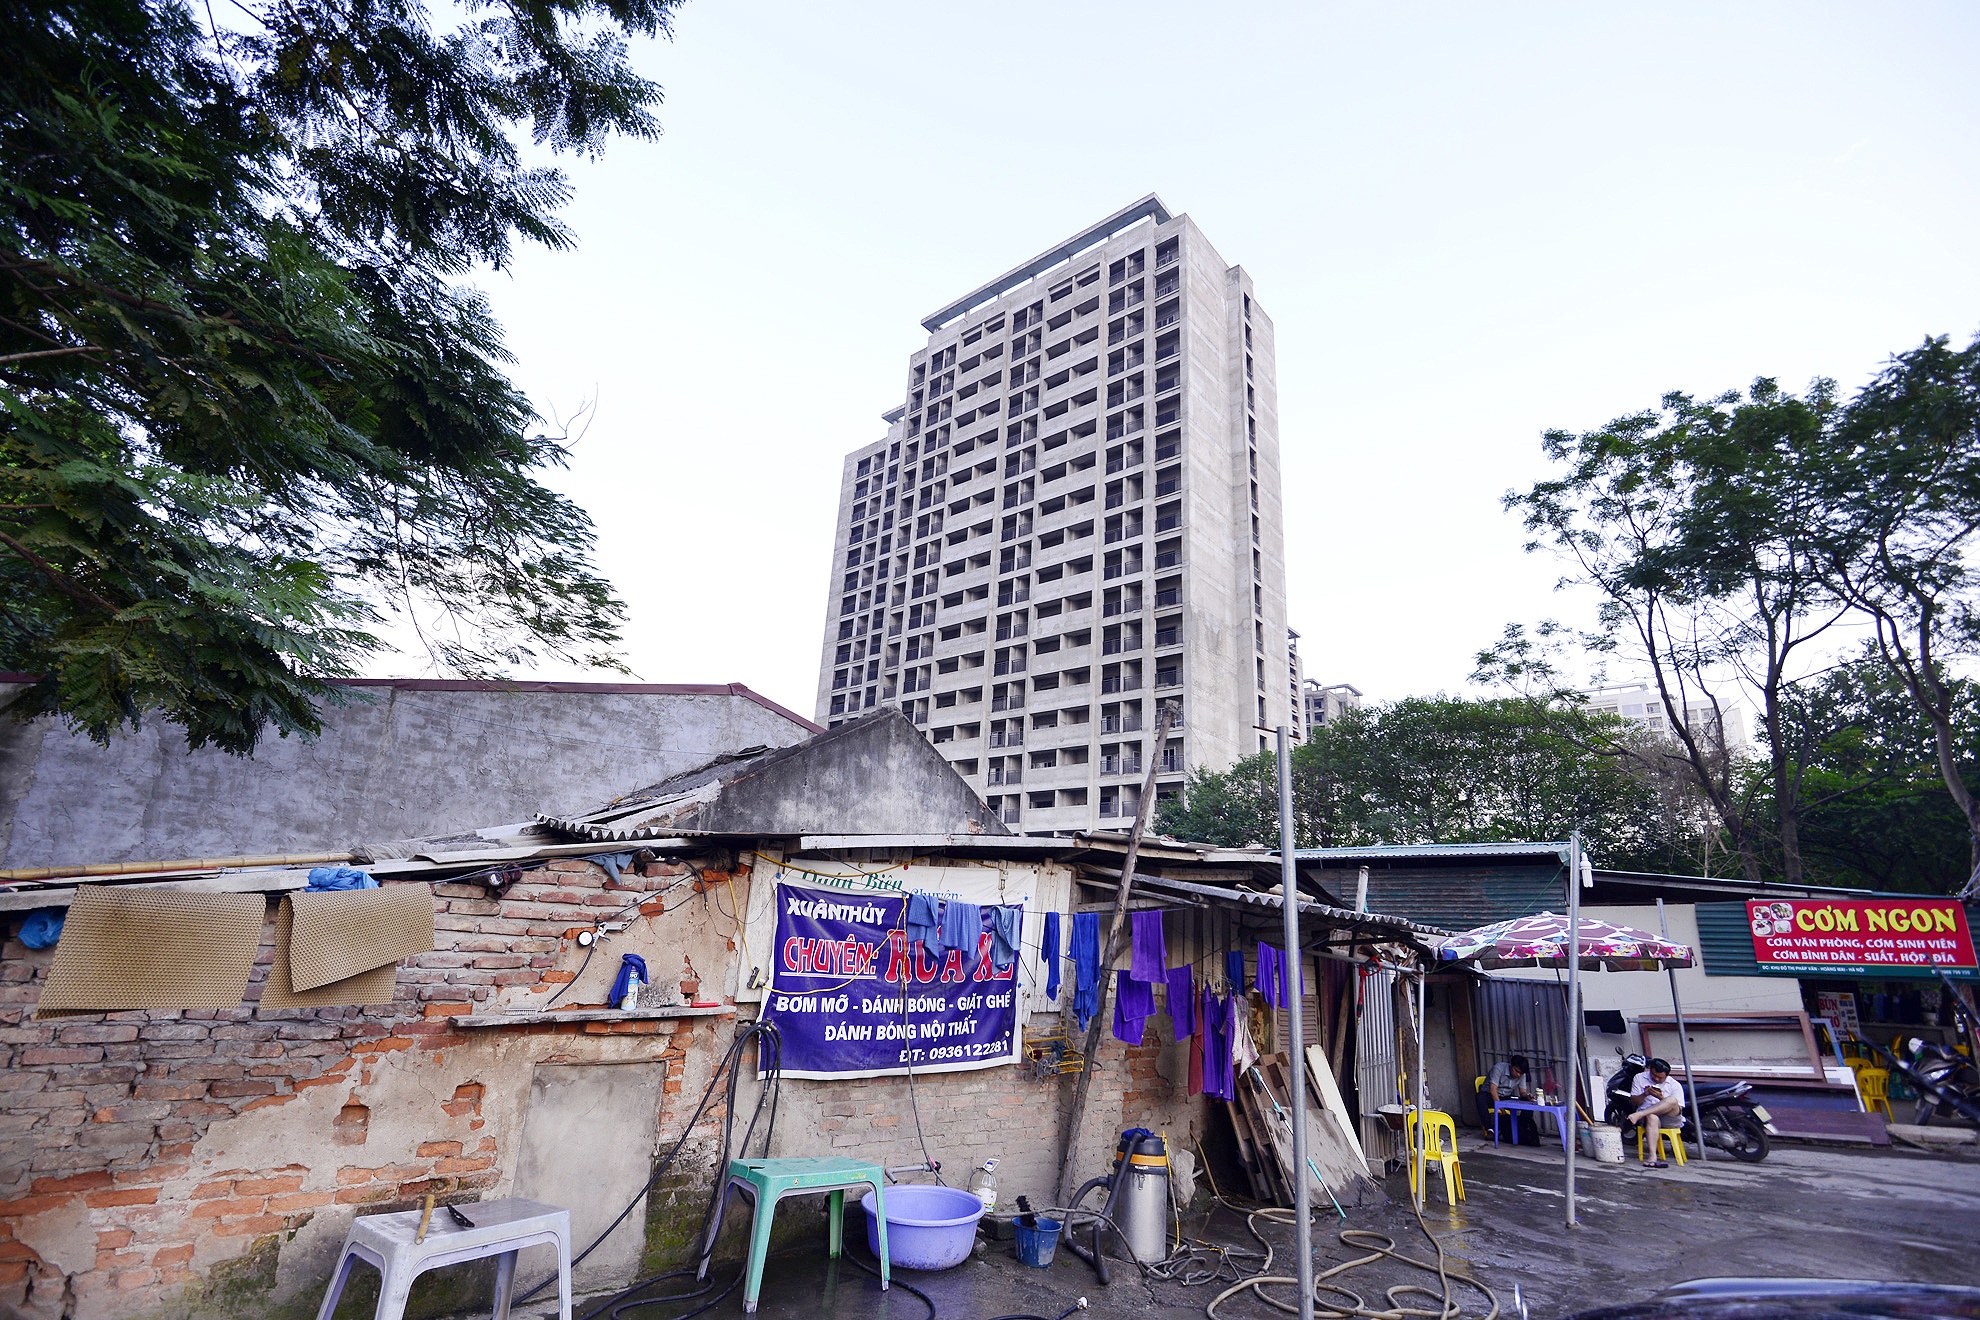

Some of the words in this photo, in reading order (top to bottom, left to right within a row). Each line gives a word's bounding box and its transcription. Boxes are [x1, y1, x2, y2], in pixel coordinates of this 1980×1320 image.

[1796, 905, 1860, 932] CƠM
[1864, 908, 1958, 933] NGON
[784, 934, 878, 975] CHUYÊN:
[1766, 938, 1793, 947] CƠM
[1794, 937, 1818, 947] VĂN
[1820, 937, 1865, 949] PHÒNG,
[1866, 938, 1894, 949] CƠM
[1897, 939, 1926, 949] SINH
[1928, 938, 1957, 949] VIÊN
[1773, 950, 1799, 960] CƠM
[1801, 949, 1829, 961] BÌNH
[1831, 950, 1856, 962] DÂN
[1864, 949, 1899, 963] SUẤT,
[776, 995, 817, 1013] BƠM
[820, 994, 849, 1013] MỠ
[862, 996, 905, 1014] ĐÁNH
[907, 995, 946, 1013] BÓNG
[958, 994, 984, 1014] GIẶT
[985, 989, 1013, 1009] GHẾ
[825, 1022, 872, 1041] ĐÁNH
[876, 1020, 917, 1041] BÓNG
[920, 1019, 945, 1042] NỘI
[948, 1015, 978, 1036] THẤT
[929, 1040, 1009, 1061] 0936122281
